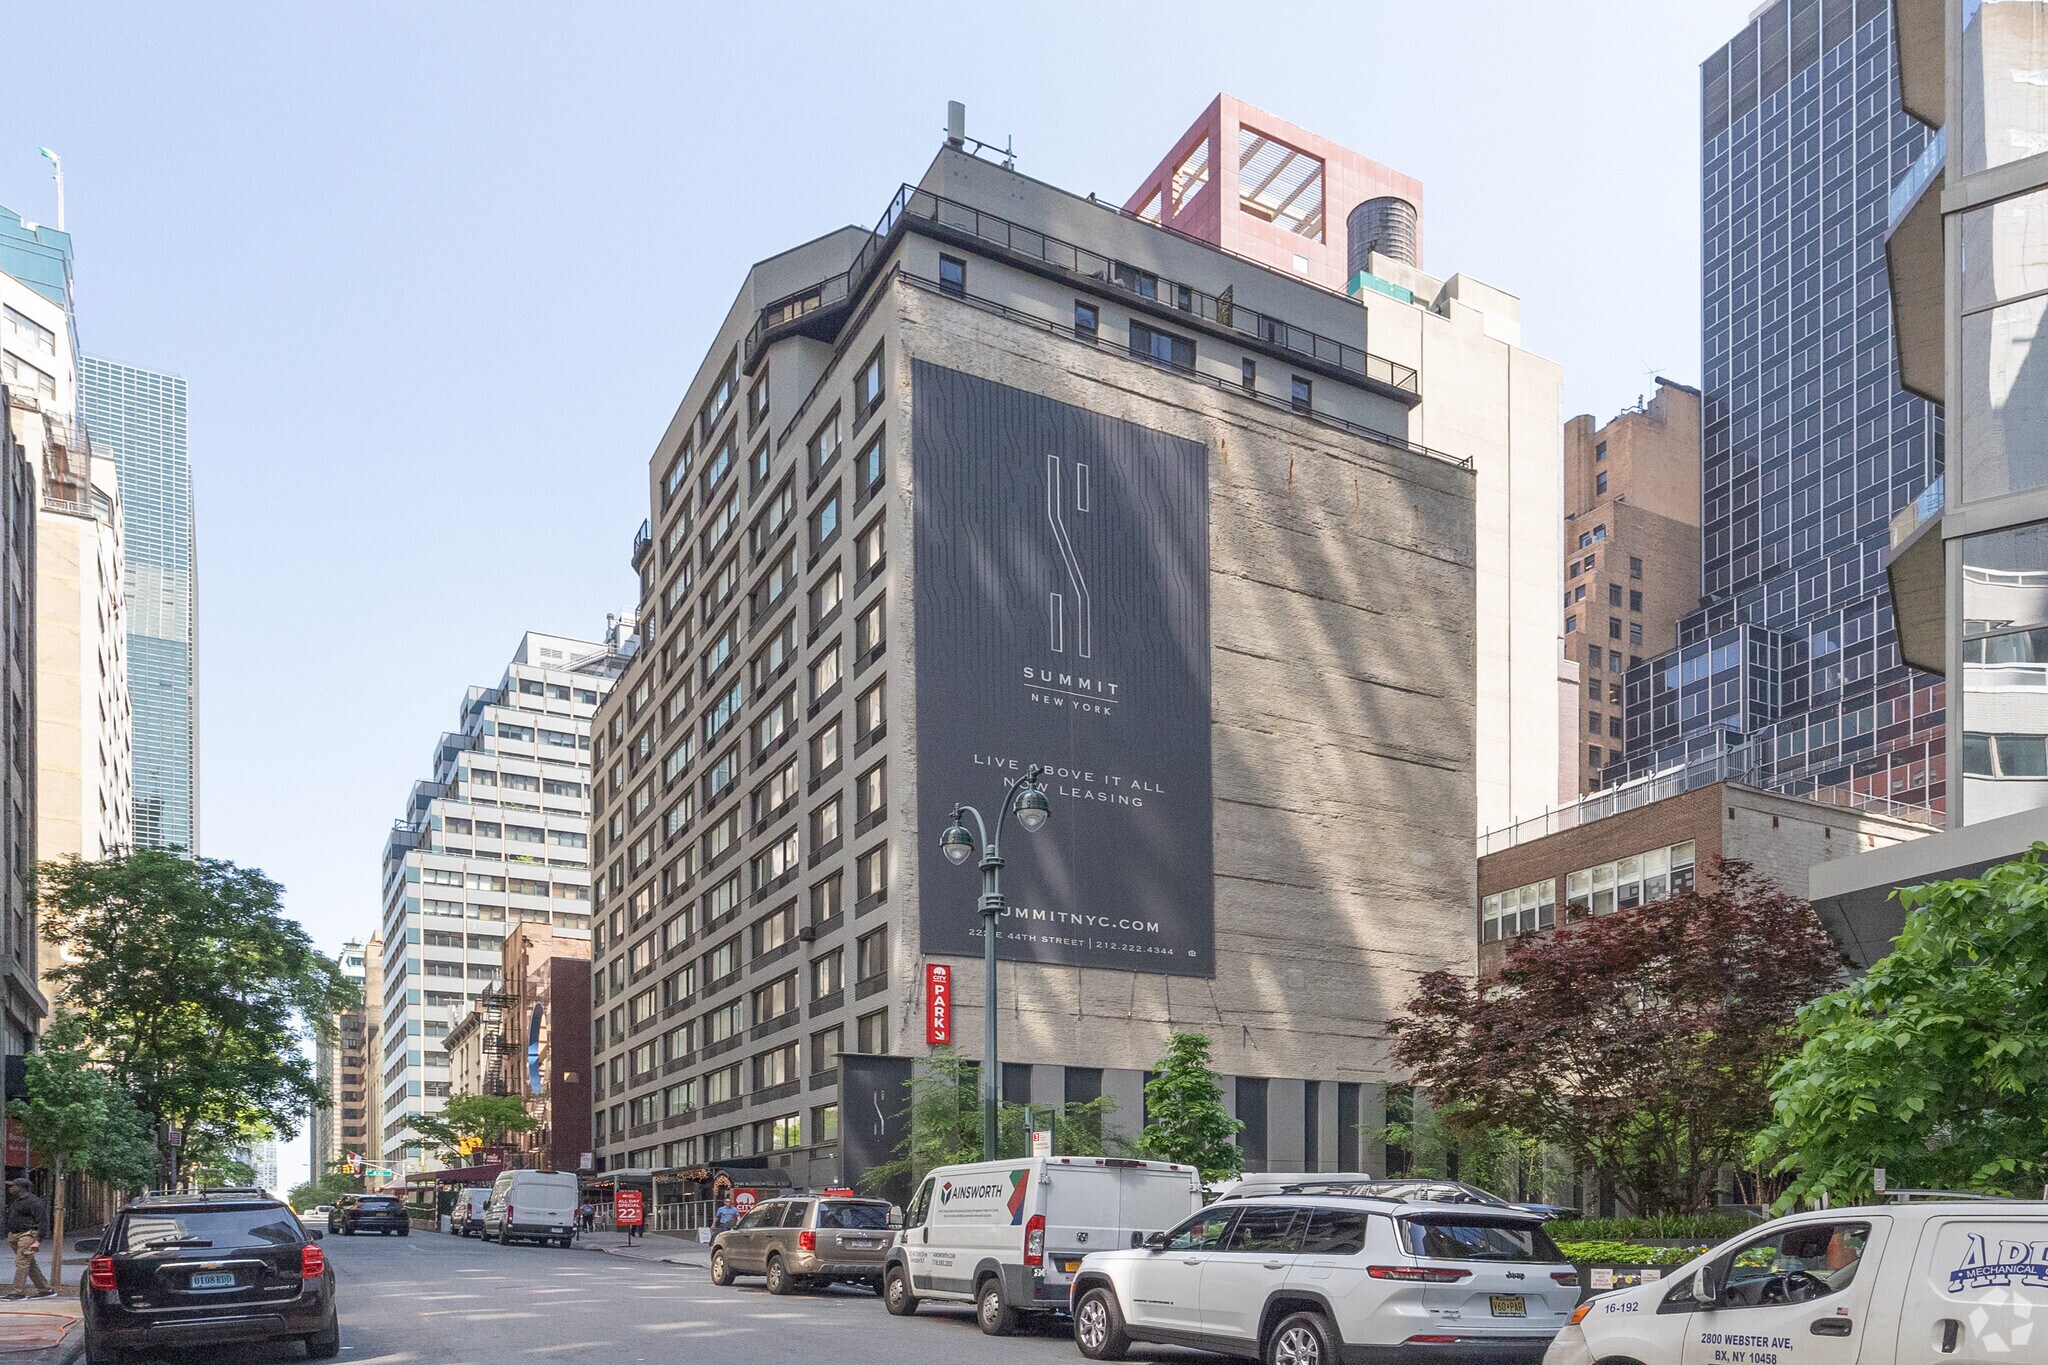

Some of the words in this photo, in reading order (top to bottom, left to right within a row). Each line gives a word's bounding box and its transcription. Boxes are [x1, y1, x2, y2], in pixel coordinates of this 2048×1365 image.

[1023, 666, 1119, 695] SUMMIT
[1031, 693, 1064, 707] NEW
[1072, 701, 1111, 716] YORK
[974, 753, 1019, 770] LIVE
[1105, 775, 1121, 786] IT
[1130, 780, 1165, 794] ALL
[1059, 785, 1143, 807] LEASING
[996, 906, 1160, 933] UMMITNYC.COM
[995, 931, 1003, 939] E
[1007, 932, 1037, 942] 44TH
[1041, 935, 1085, 947] STREET
[1096, 941, 1175, 956] 212.222.4344
[933, 984, 946, 1029] PARK
[951, 1184, 1003, 1200] AINSWORTH
[618, 1208, 636, 1219] 22
[1505, 1270, 1525, 1280] Jeep
[1966, 1264, 2038, 1278] MECHANICAL
[1604, 1301, 1639, 1314] 16-192
[1701, 1333, 1723, 1344] 2800
[1724, 1334, 1769, 1348] WEBSTER
[1771, 1337, 1794, 1351] AVE,
[1715, 1350, 1730, 1363] BX,
[1732, 1351, 1746, 1362] NY
[1749, 1352, 1777, 1364] 10458
